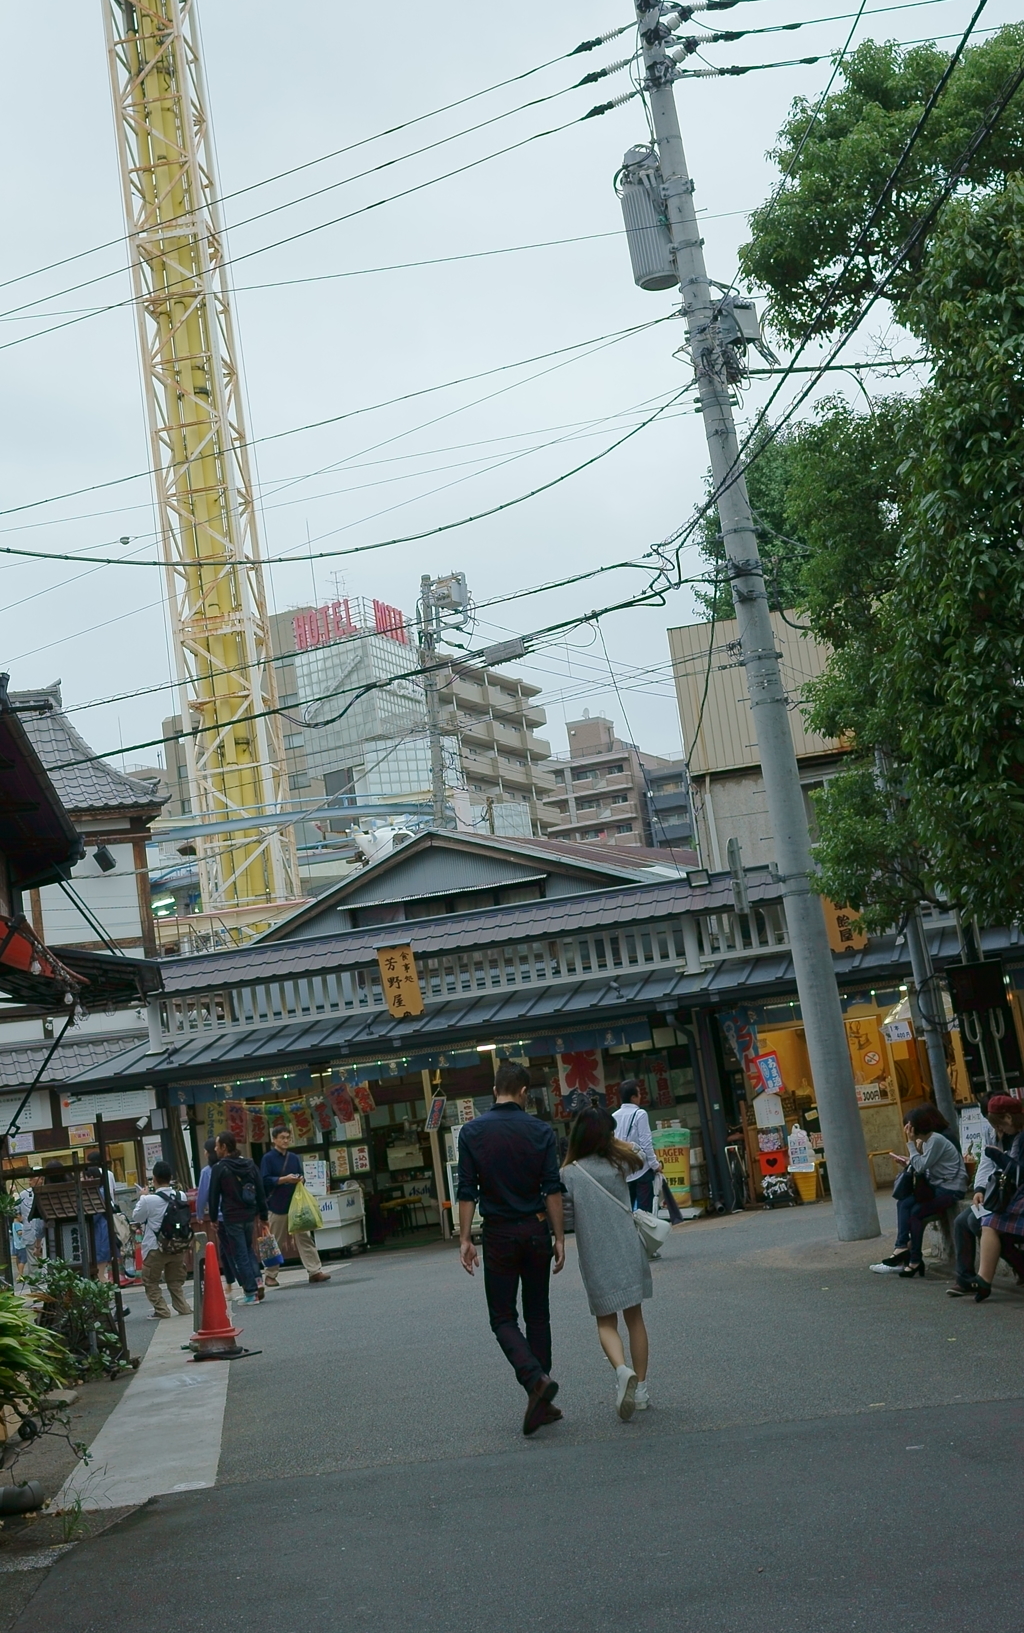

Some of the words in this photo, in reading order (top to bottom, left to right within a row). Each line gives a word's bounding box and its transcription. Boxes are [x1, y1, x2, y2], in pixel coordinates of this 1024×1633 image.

[293, 599, 357, 650] HOTEL
[373, 598, 408, 645] HOTEL
[399, 951, 415, 983] 食事処
[384, 956, 406, 1008] 芳野屋
[862, 1090, 880, 1102] 300円
[658, 1148, 684, 1157] LAGER
[409, 1184, 431, 1196] Asah
[666, 1176, 685, 1186] 野屋
